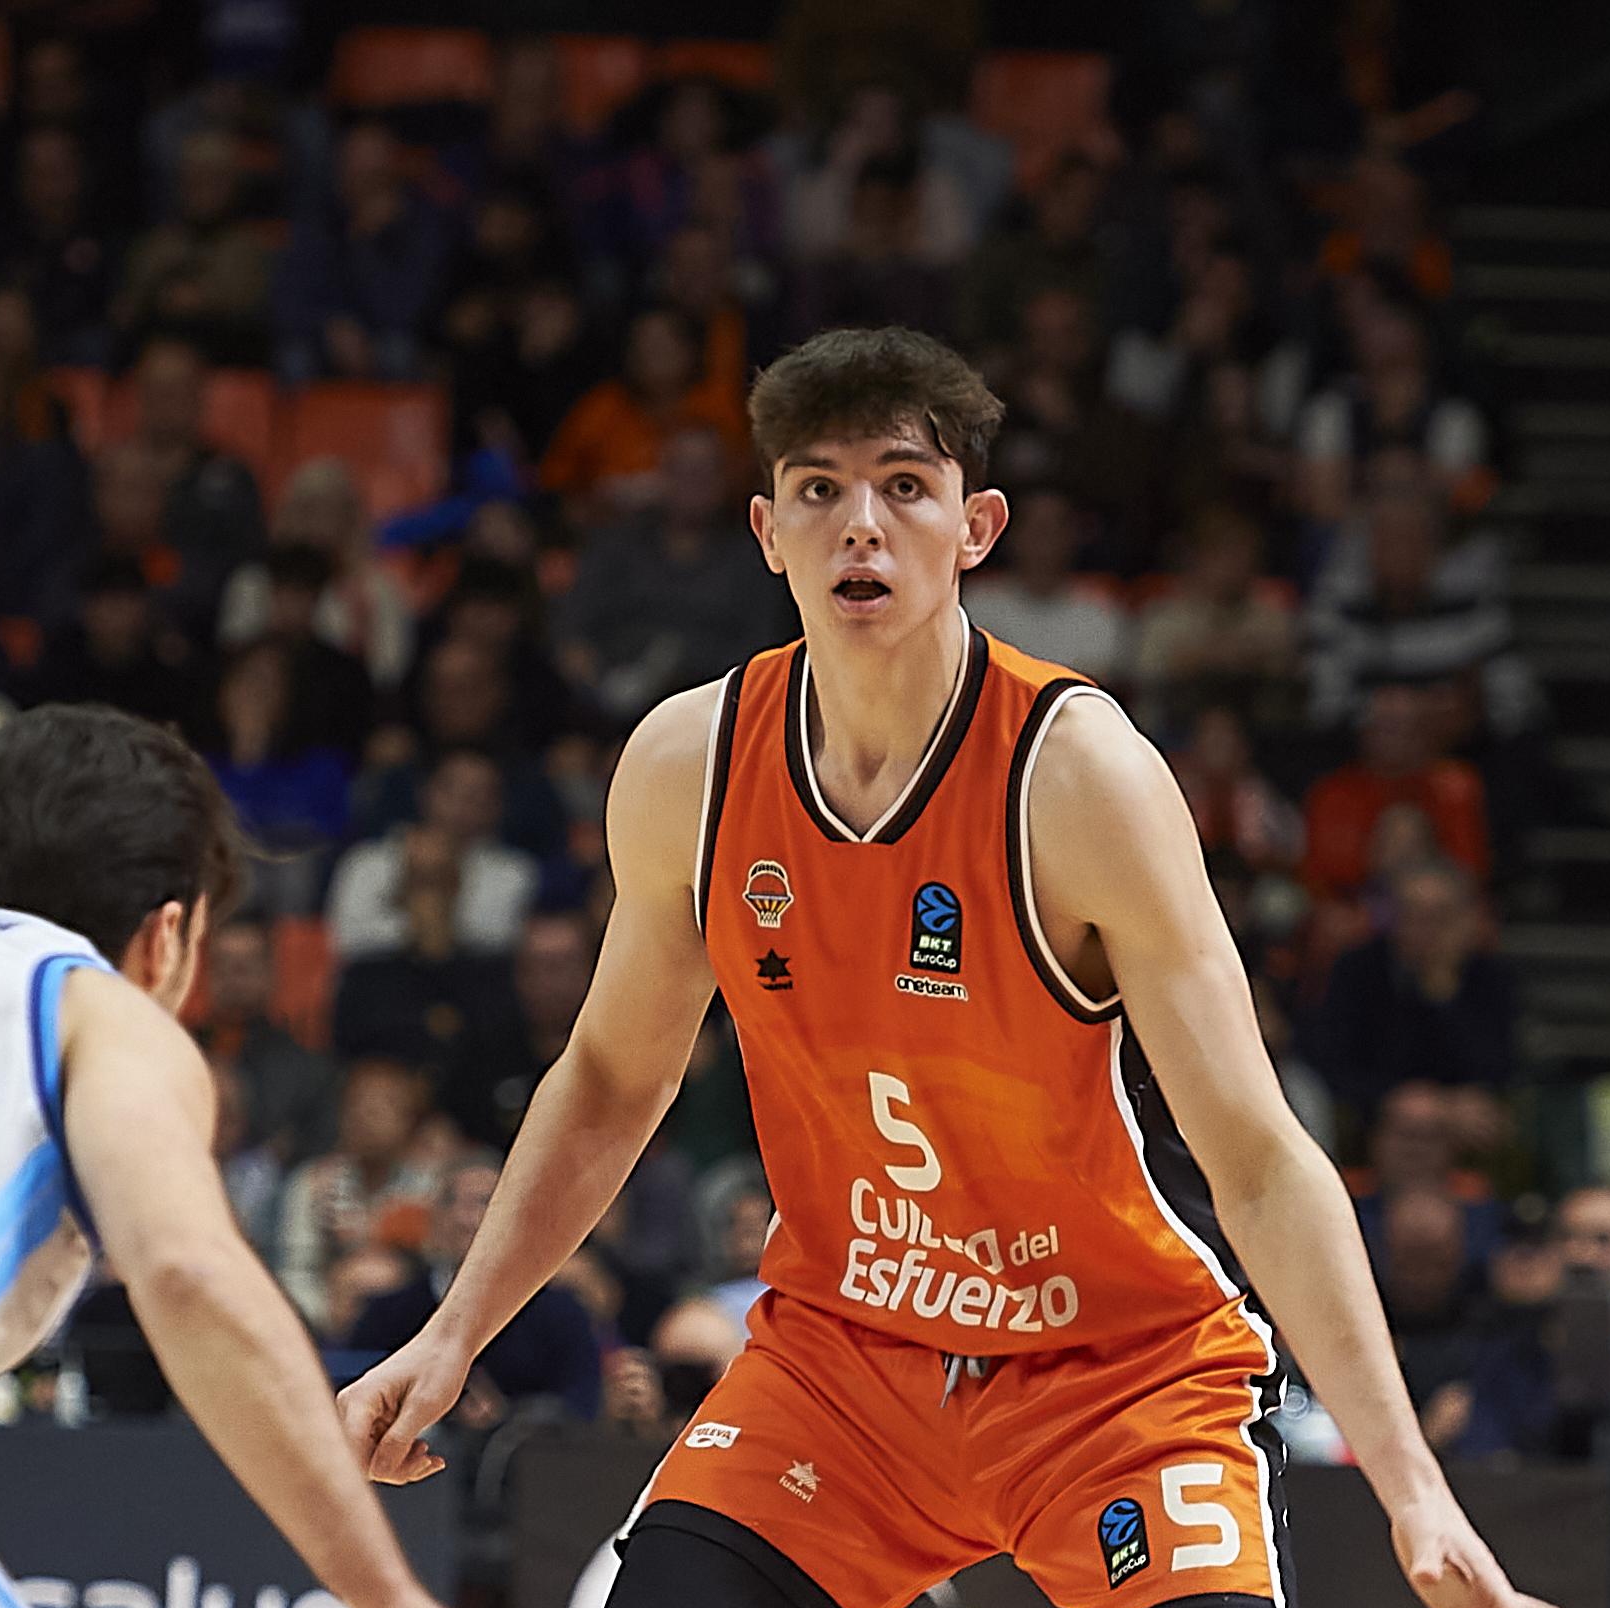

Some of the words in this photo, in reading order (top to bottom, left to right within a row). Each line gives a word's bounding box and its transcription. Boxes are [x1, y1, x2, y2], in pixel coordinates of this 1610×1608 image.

[918, 934, 953, 953] BKT
[913, 951, 957, 970] EuroCup
[895, 976, 968, 1000] oneteam
[868, 1071, 942, 1192] 5
[1009, 1225, 1059, 1267] del
[839, 1238, 1079, 1333] Esfuerzo
[777, 1475, 814, 1504] luanvi
[1160, 1462, 1241, 1573] 5
[1110, 1553, 1147, 1585] EuroCup
